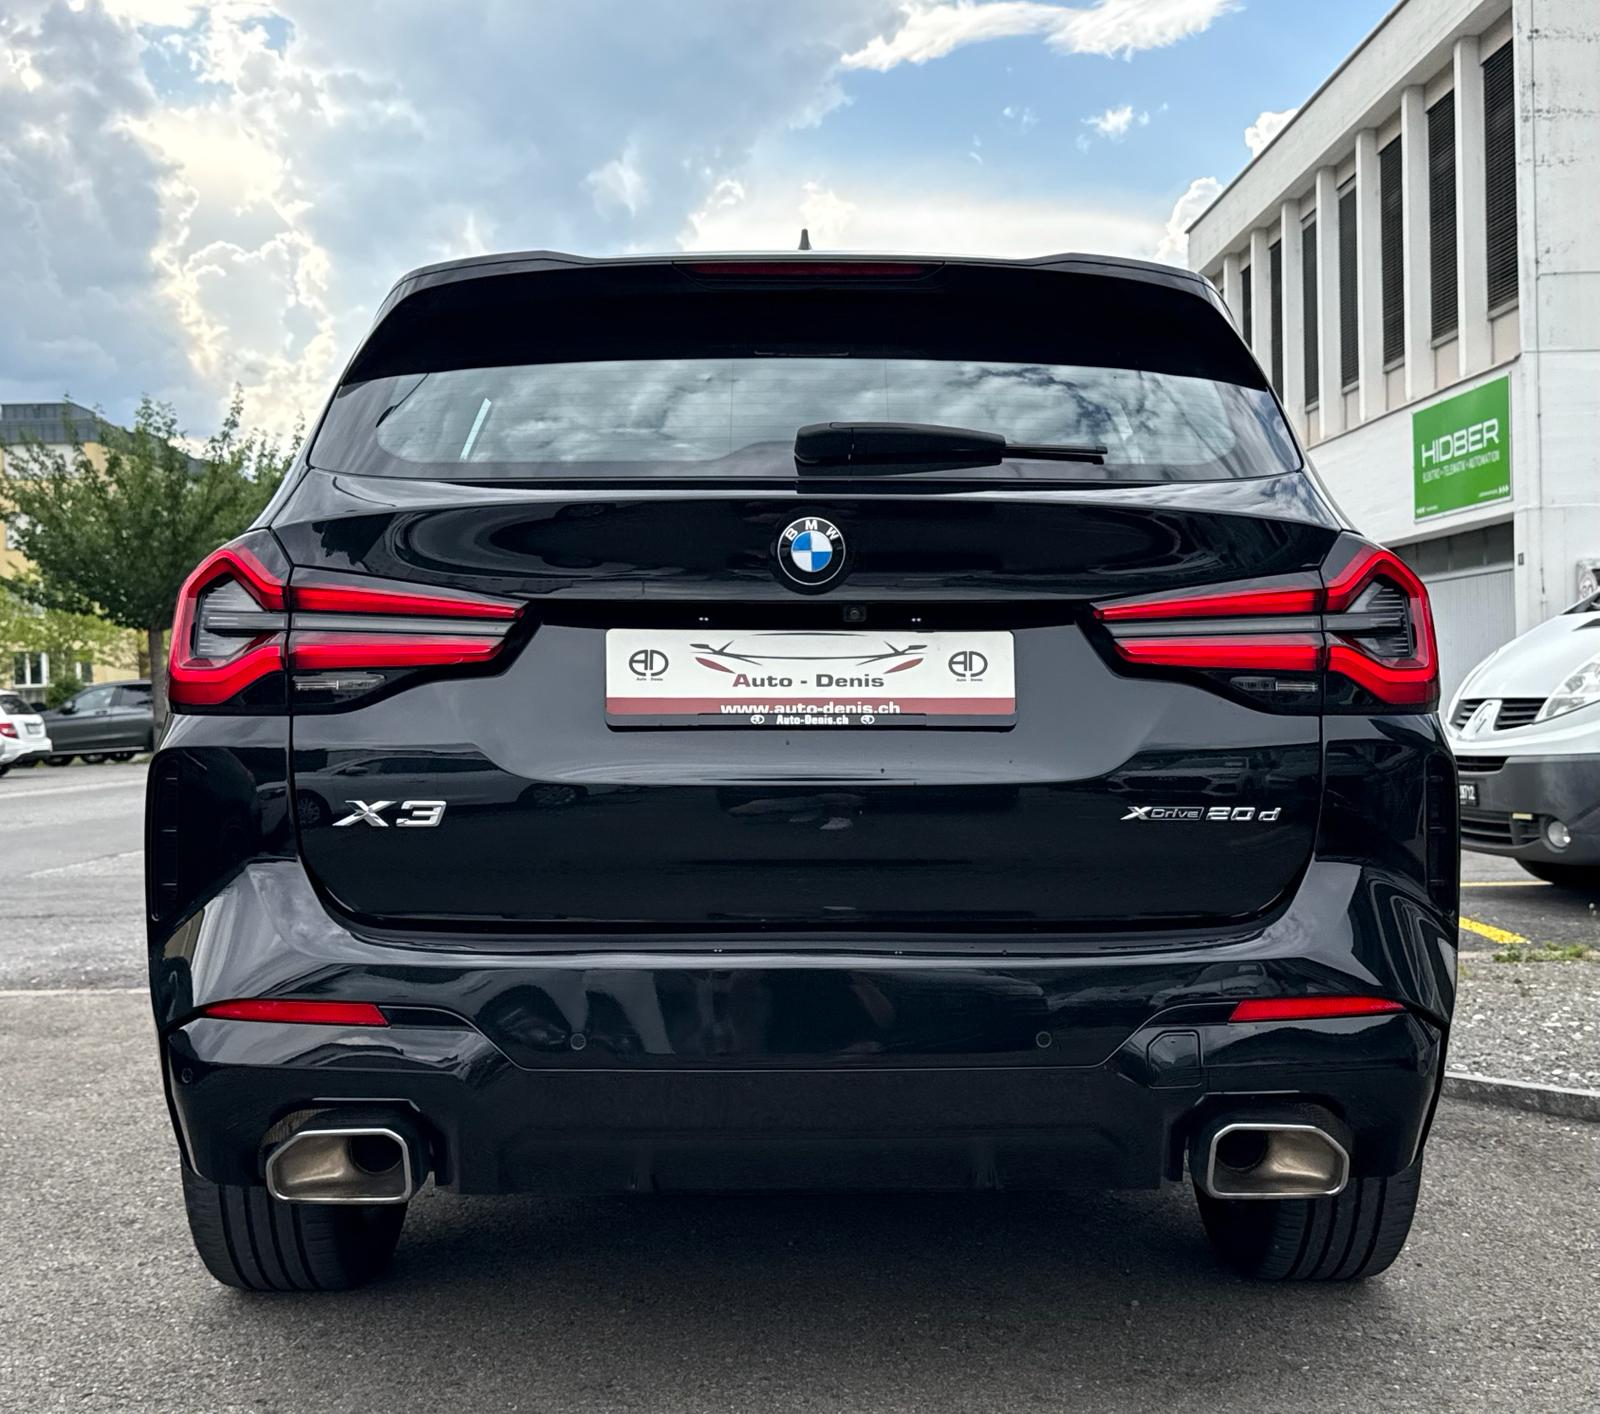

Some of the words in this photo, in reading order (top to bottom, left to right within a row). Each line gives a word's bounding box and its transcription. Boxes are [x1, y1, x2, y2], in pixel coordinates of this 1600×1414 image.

[1421, 418, 1499, 468] HIDBER
[785, 520, 839, 541] BMW
[732, 673, 793, 687] Auto
[815, 673, 885, 688] Denis
[720, 701, 900, 714] www.auto-denis.ch
[776, 714, 849, 725] Auto-Denis.ch
[332, 800, 447, 827] X3
